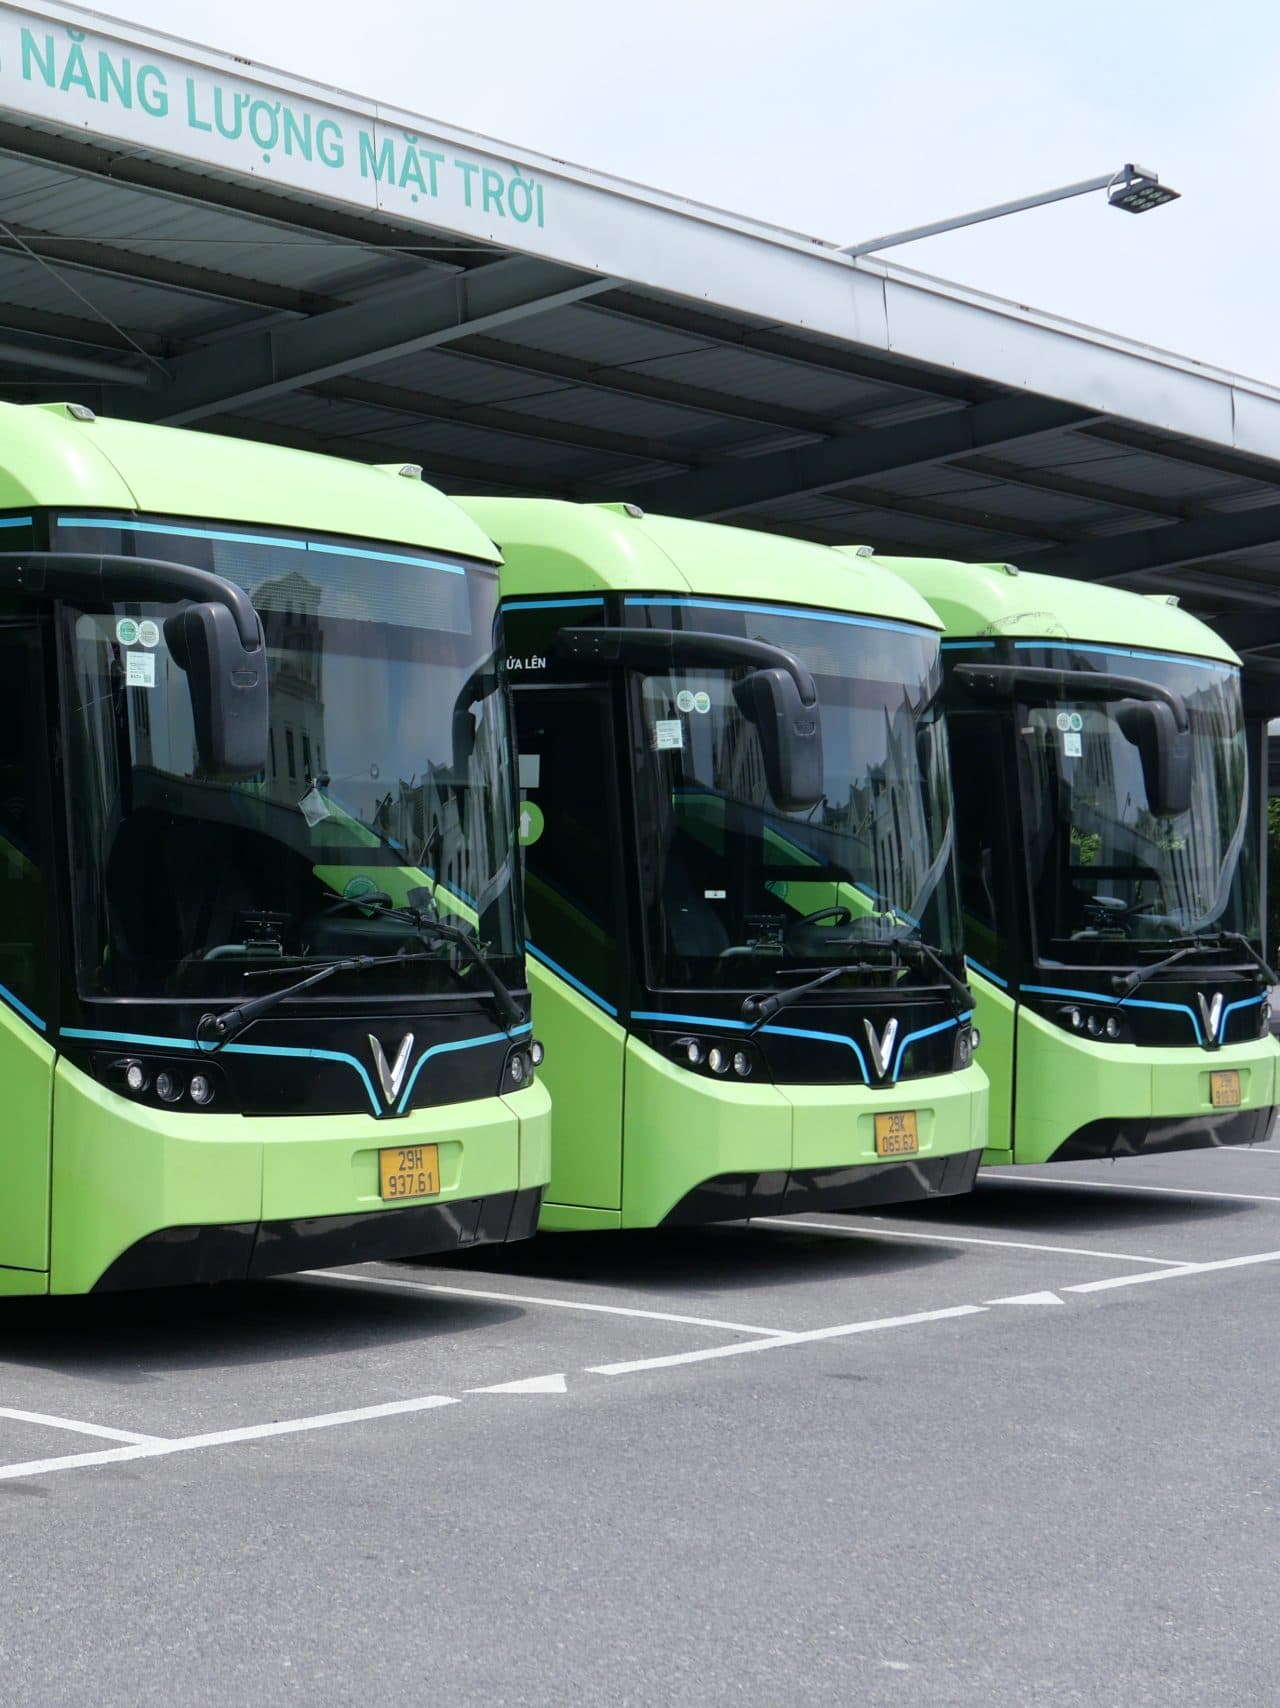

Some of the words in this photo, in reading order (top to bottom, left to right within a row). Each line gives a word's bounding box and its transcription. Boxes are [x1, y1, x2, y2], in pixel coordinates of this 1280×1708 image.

[20, 27, 169, 117] NĂNG
[186, 77, 344, 169] LƯỢNG
[358, 131, 445, 203] MẶT
[454, 159, 544, 229] TRỜI
[506, 655, 523, 670] ỬA
[525, 654, 546, 669] LÊN
[398, 1149, 424, 1172] 29H
[388, 1172, 433, 1196] 937.61
